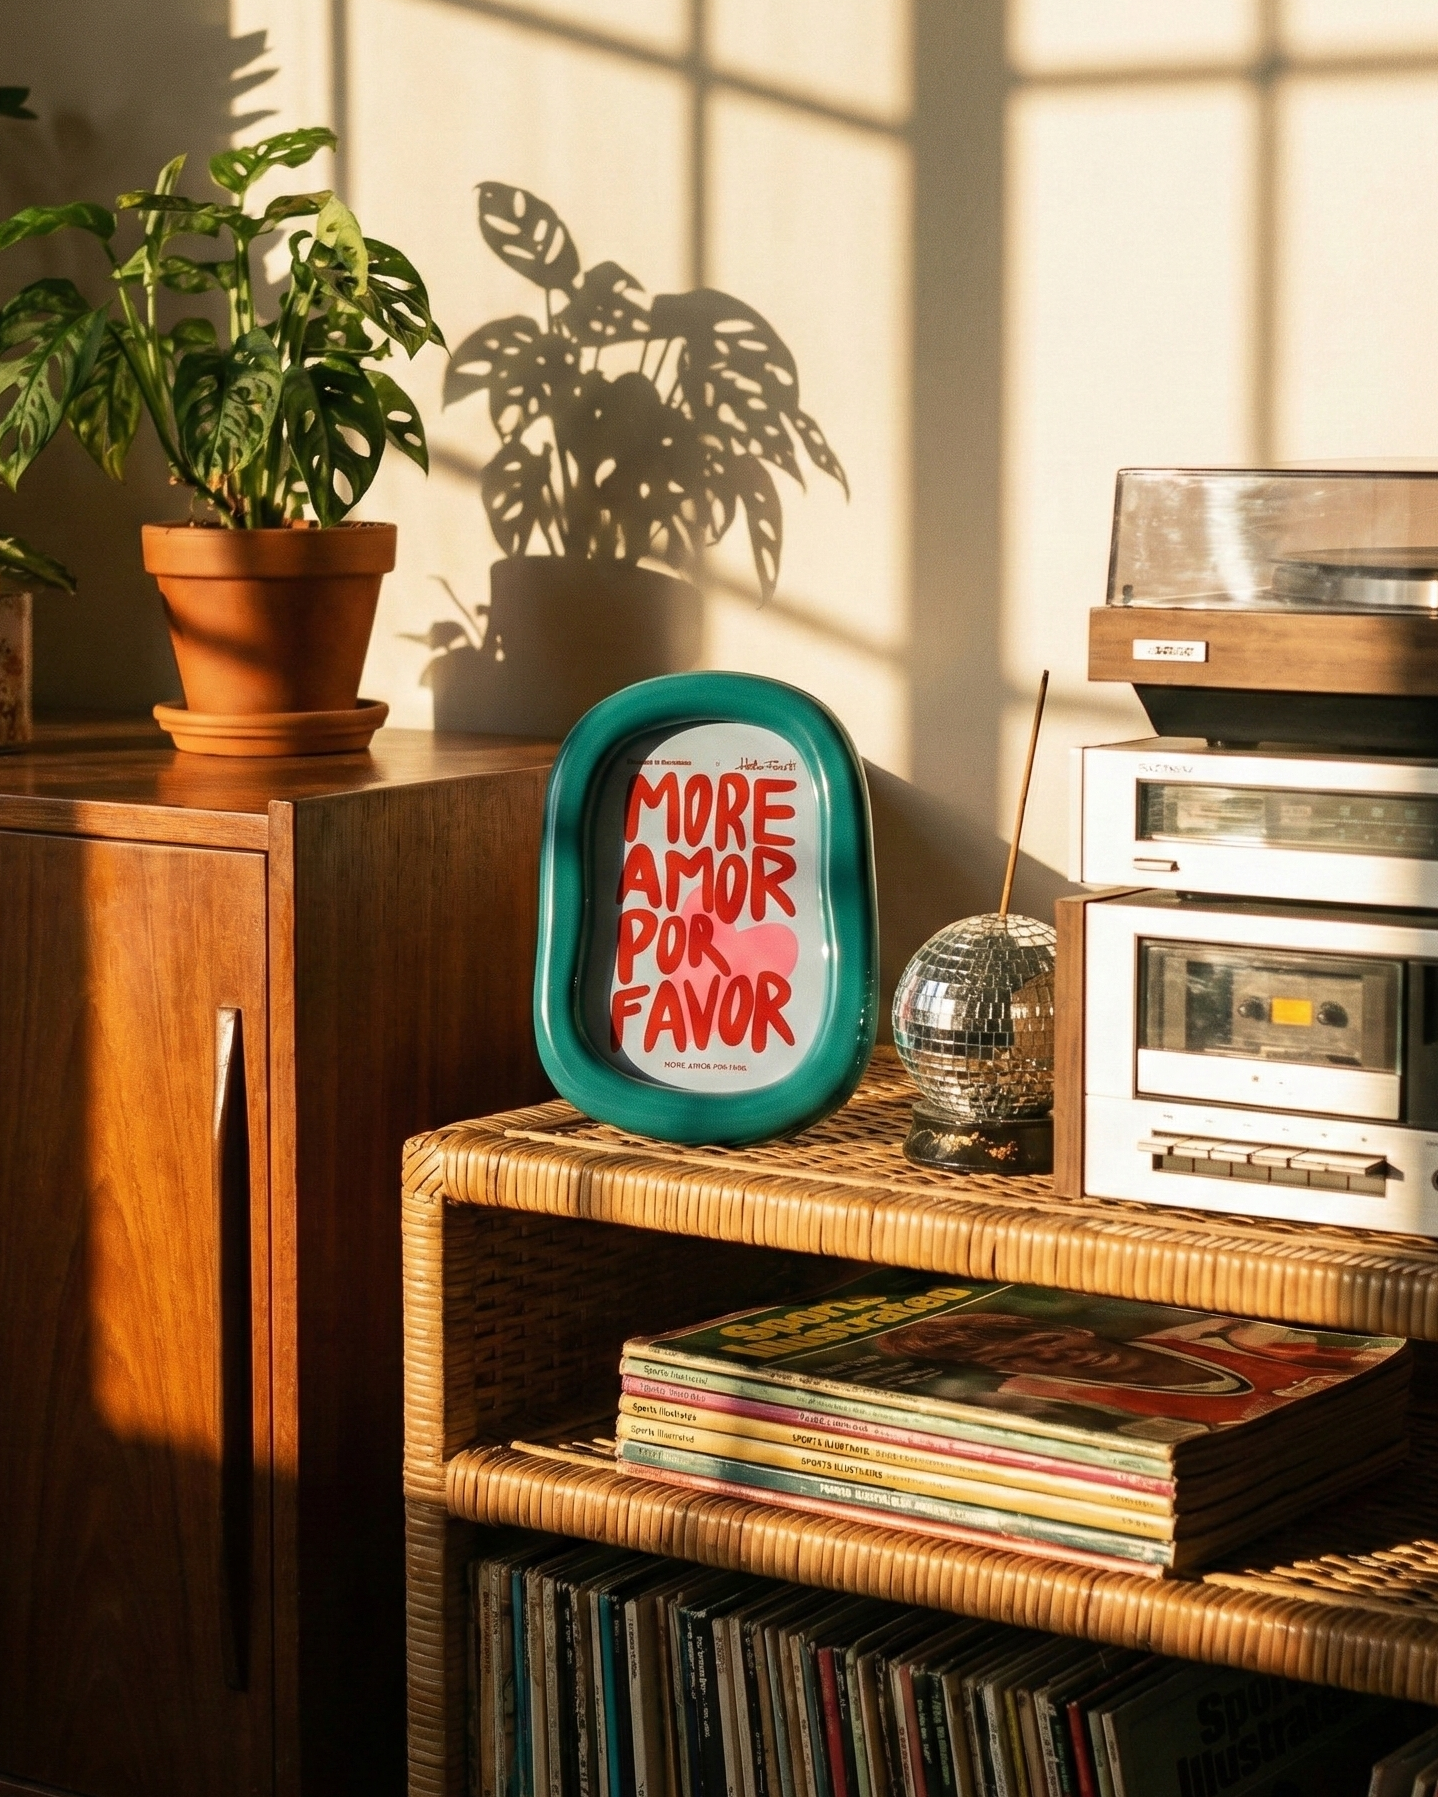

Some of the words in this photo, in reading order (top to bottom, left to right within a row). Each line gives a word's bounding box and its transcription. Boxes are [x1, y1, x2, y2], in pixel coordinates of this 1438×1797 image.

[623, 771, 797, 852] MORE
[615, 843, 797, 925] AMOR
[616, 908, 732, 985] POR
[610, 970, 797, 1054] FAVOR
[719, 1296, 887, 1341] Sports
[1196, 1676, 1302, 1745] Spor
